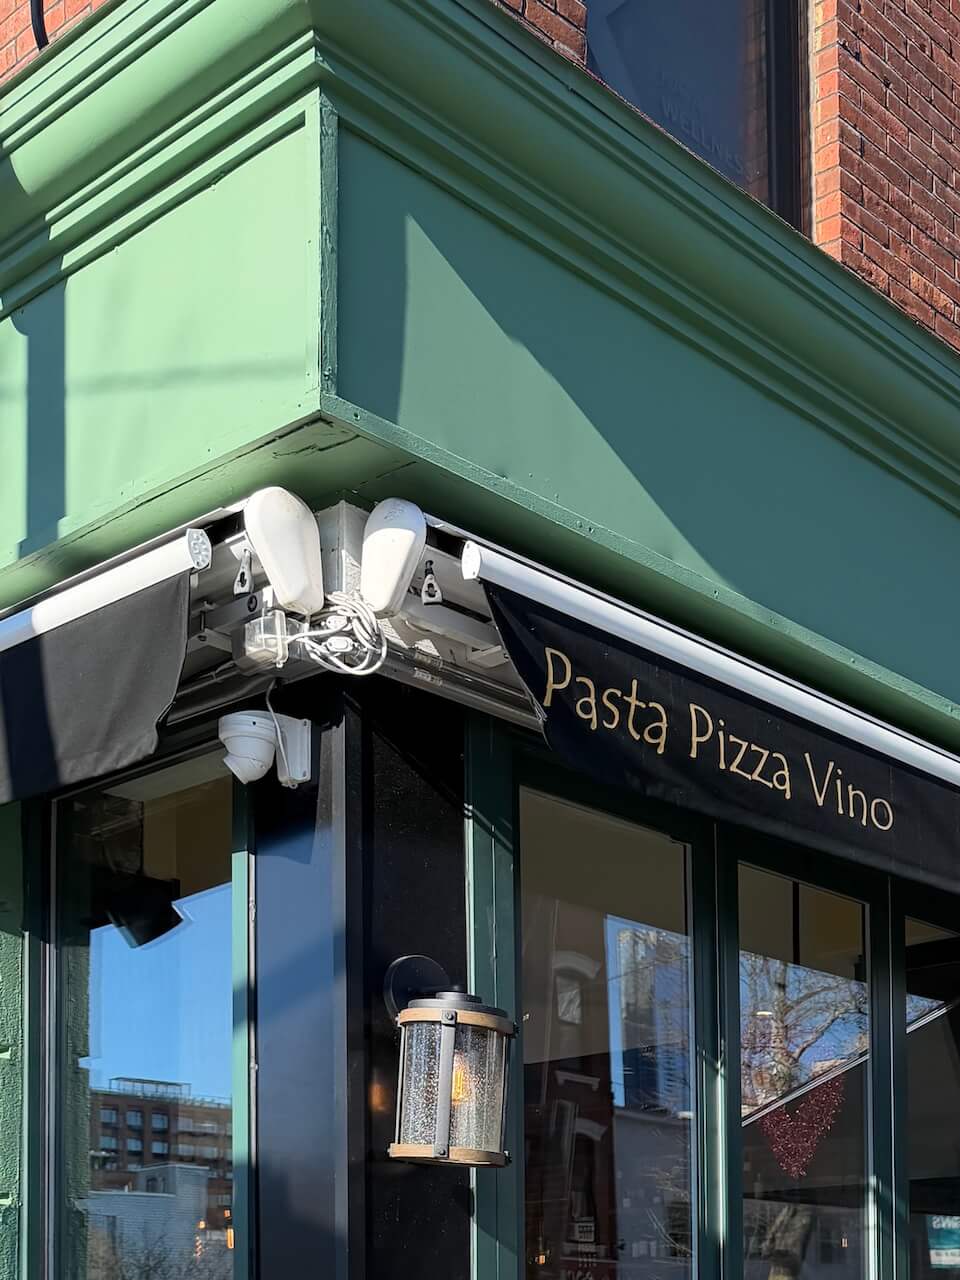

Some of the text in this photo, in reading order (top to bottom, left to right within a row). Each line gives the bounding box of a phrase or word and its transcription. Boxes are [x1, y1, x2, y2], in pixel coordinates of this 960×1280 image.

[543, 647, 894, 831] Pasta Pizza Vino
